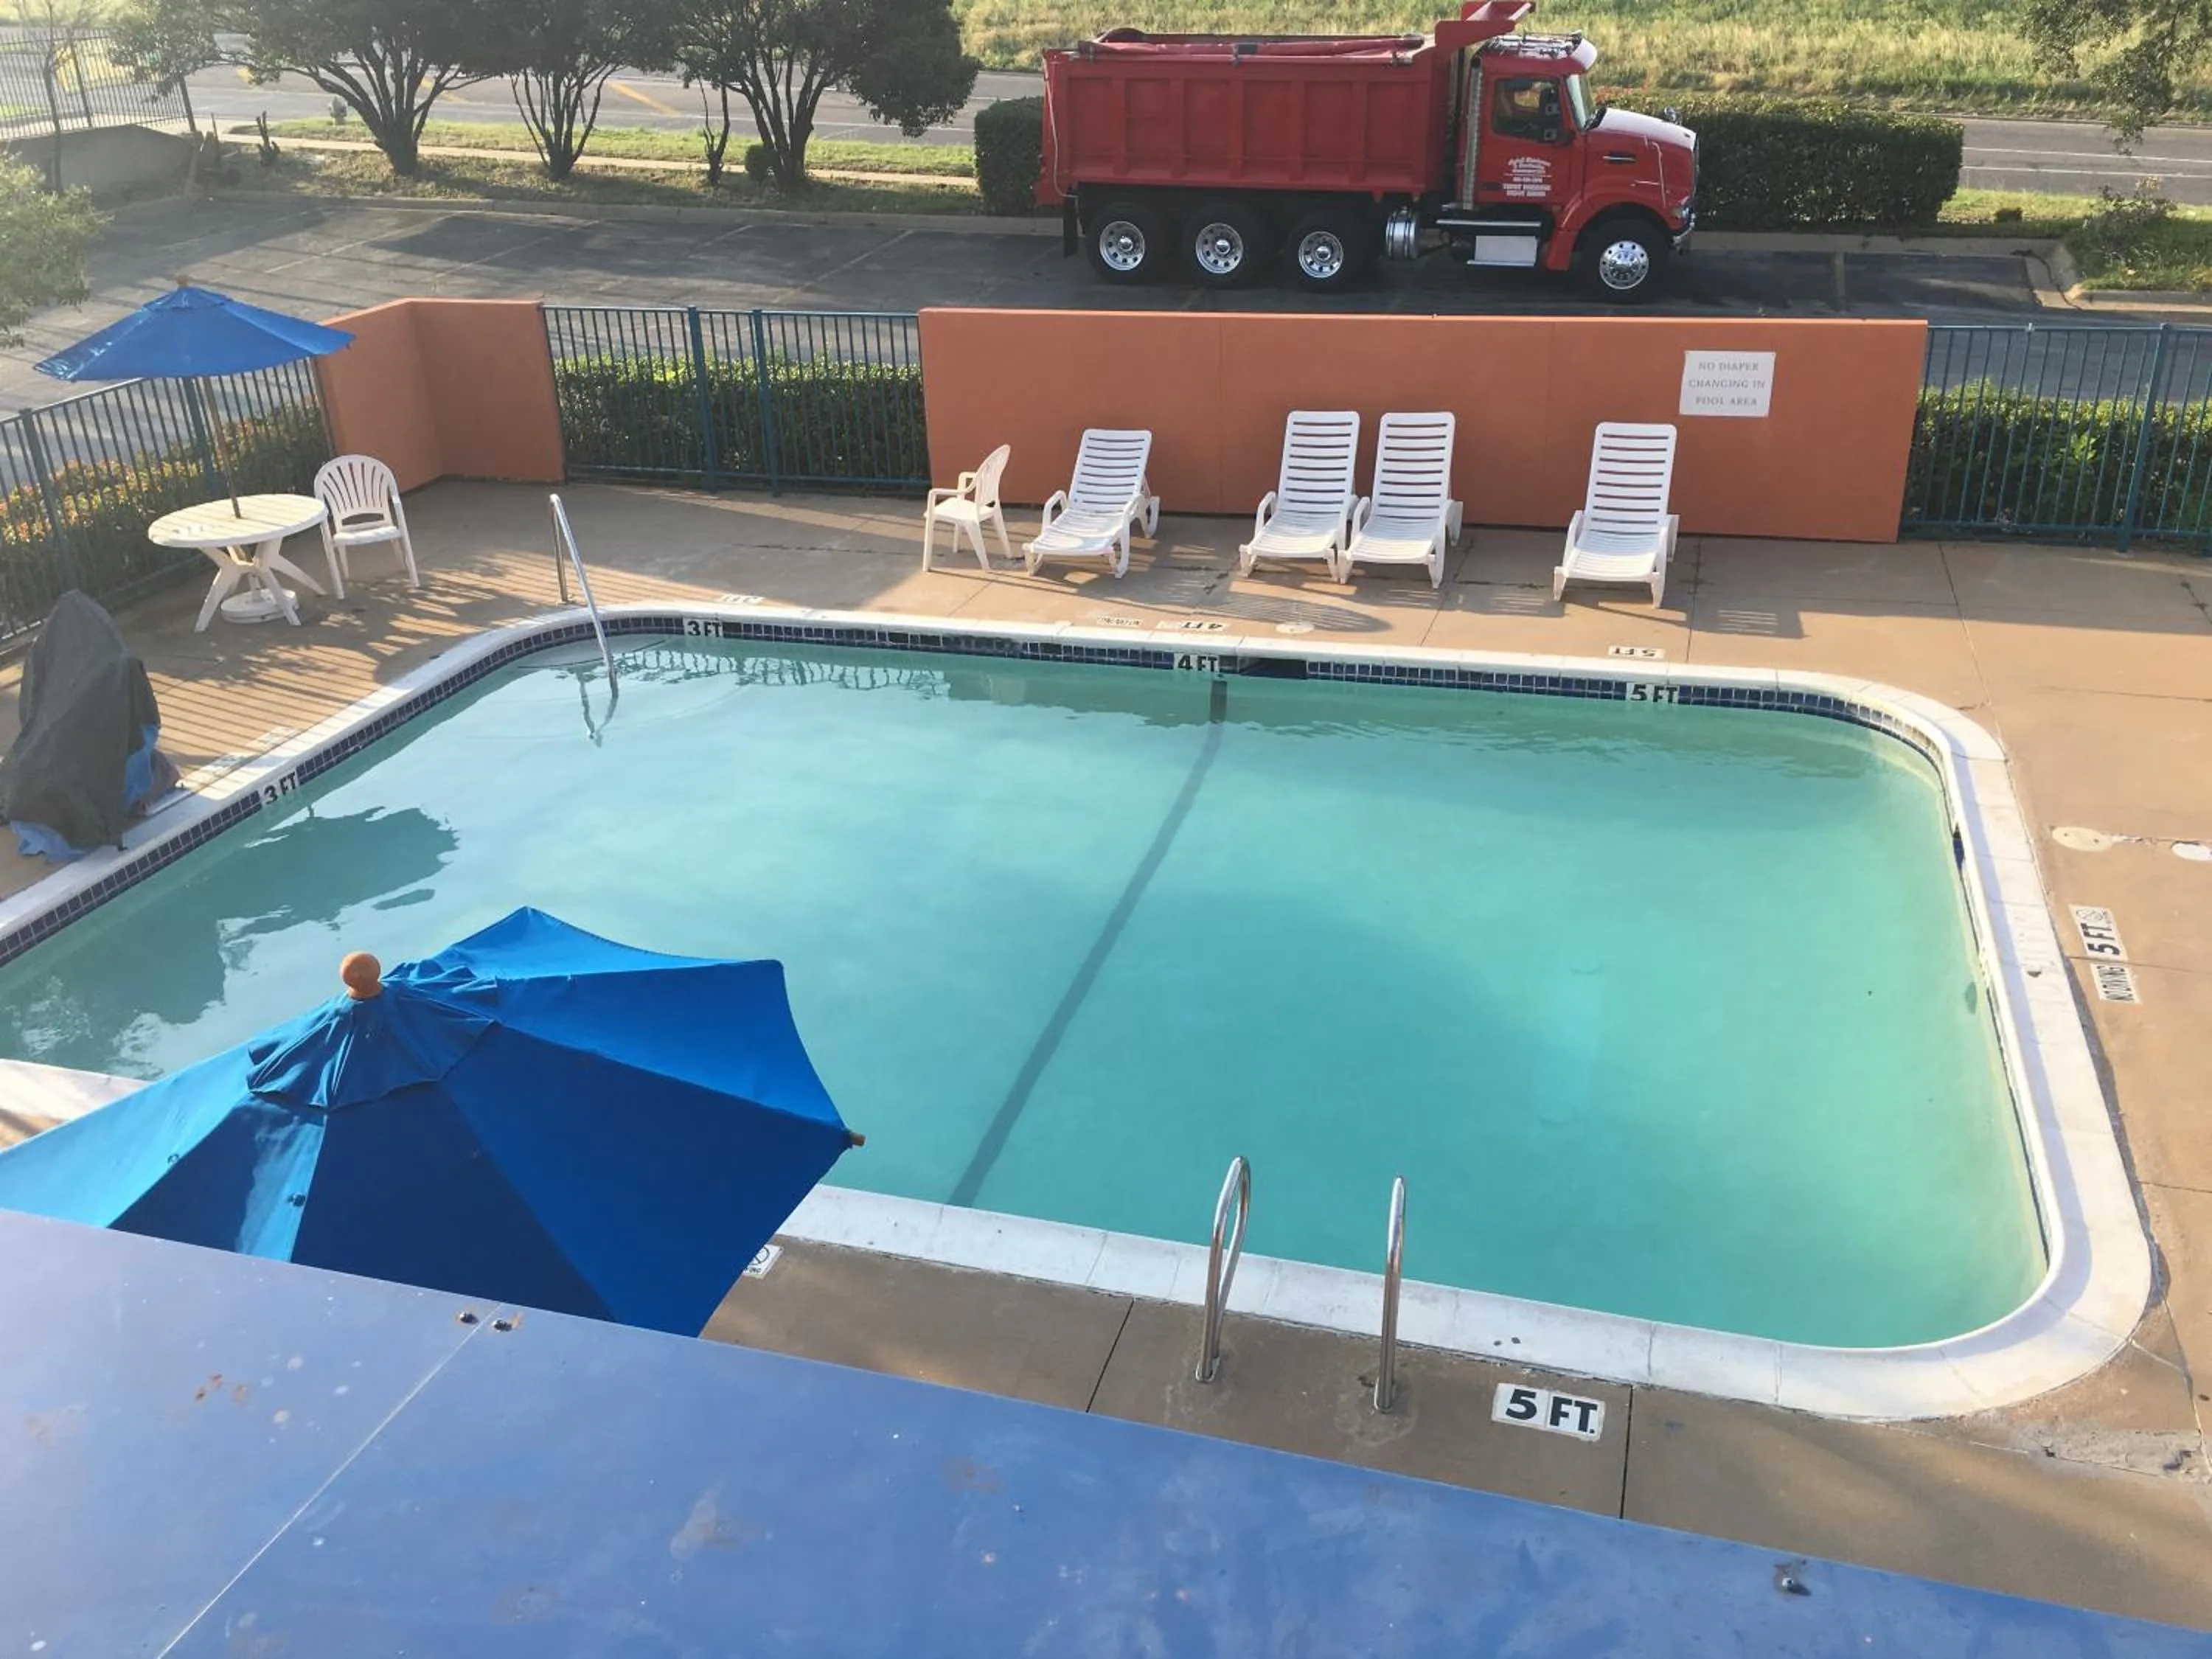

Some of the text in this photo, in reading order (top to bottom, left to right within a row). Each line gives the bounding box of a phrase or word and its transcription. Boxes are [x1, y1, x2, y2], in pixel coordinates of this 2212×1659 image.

[1698, 361, 1759, 372] NO DIAPER
[1688, 379, 1766, 389] CHANGING IN
[1695, 396, 1758, 406] POOL AREA
[686, 620, 721, 638] 3 FT
[1178, 654, 1218, 672] 4 FT
[1630, 684, 1678, 703] 5 FT
[264, 770, 296, 804] 3 FT
[2086, 942, 2121, 956] 5
[1505, 1388, 1537, 1420] 5
